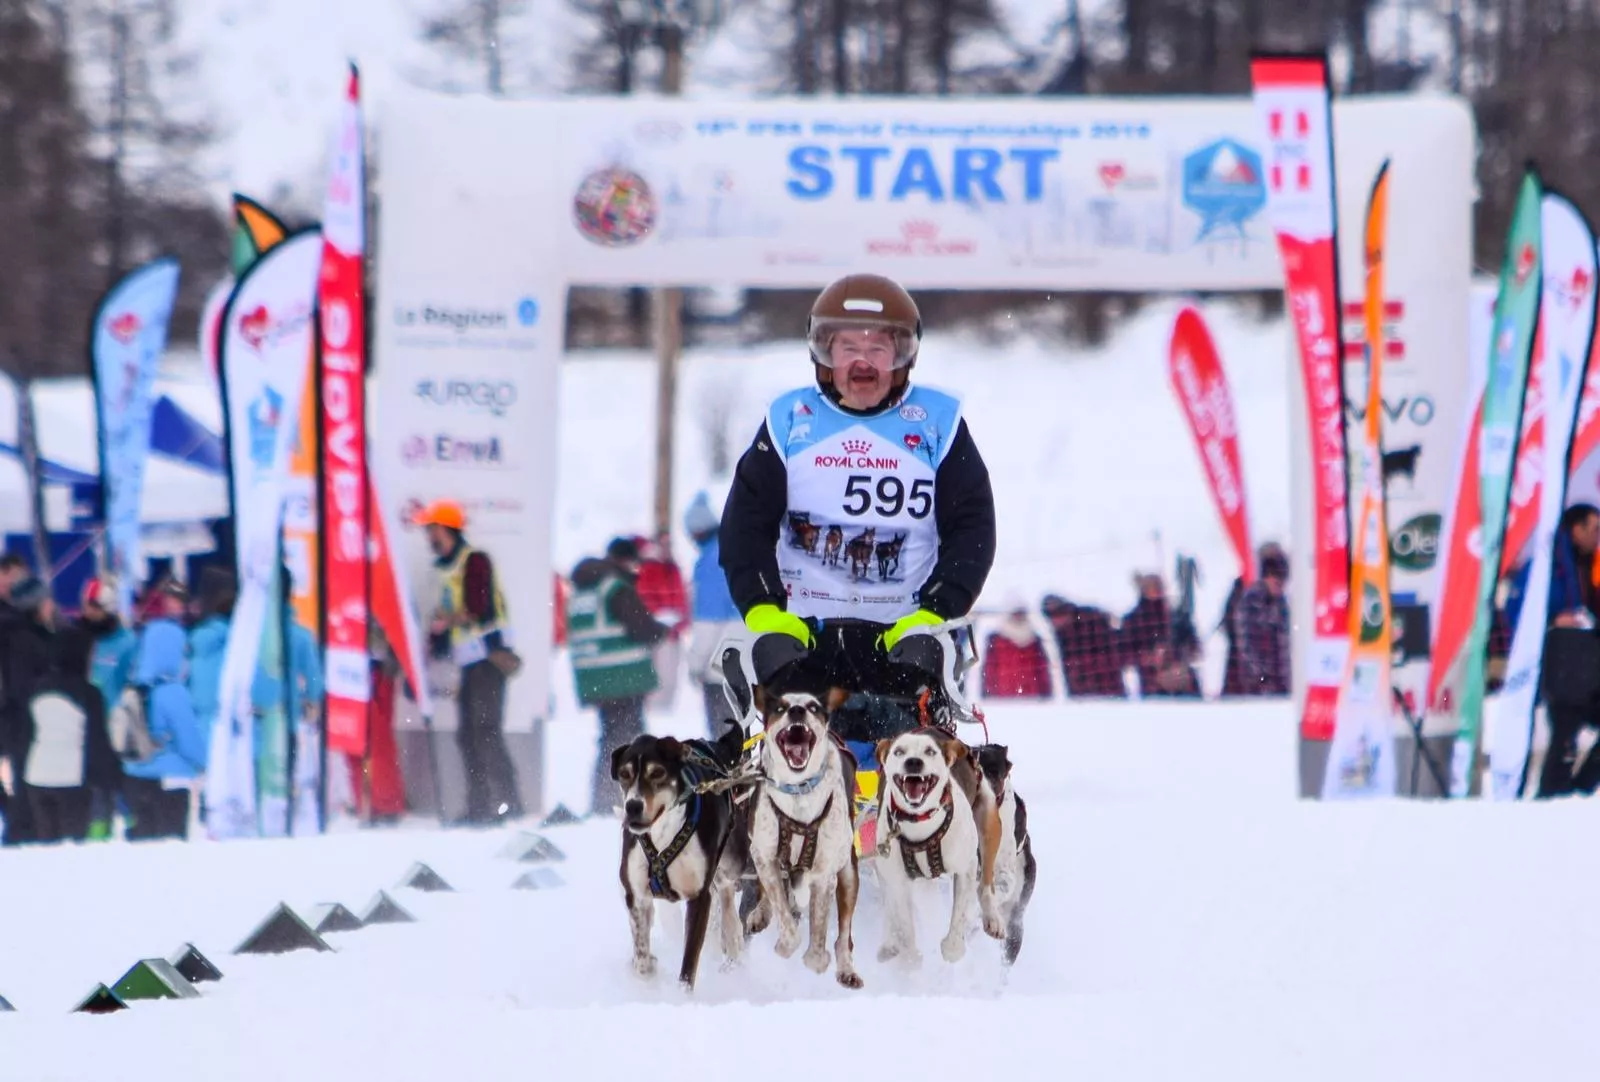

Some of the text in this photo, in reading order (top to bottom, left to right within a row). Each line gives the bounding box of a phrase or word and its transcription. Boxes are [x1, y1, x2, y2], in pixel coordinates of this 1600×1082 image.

[786, 145, 1060, 201] START
[815, 456, 898, 470] ROYAL CANIN
[841, 475, 934, 520] 595
